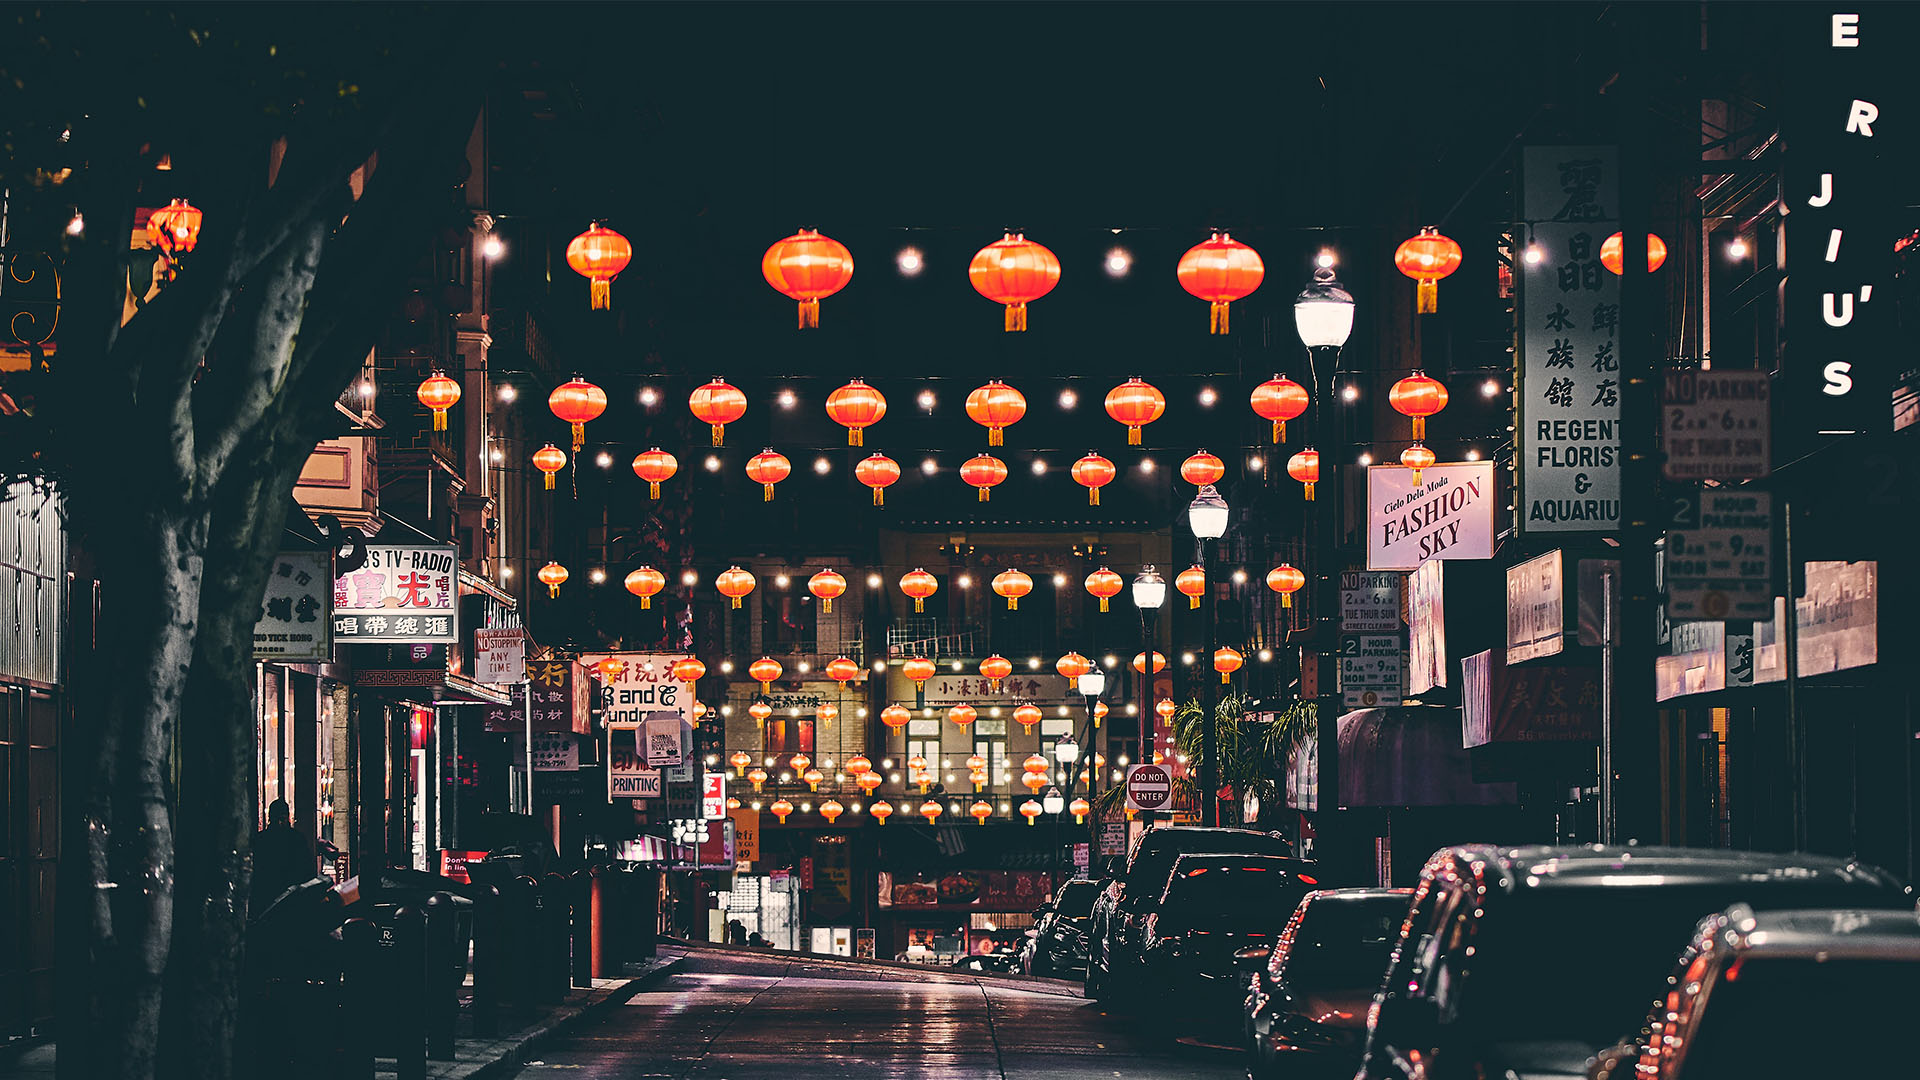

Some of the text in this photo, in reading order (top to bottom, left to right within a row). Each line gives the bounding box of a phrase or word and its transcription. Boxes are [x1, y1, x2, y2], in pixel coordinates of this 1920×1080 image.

[1664, 374, 1768, 400] NO PARKING
[1574, 473, 1593, 494] &
[1384, 476, 1448, 514] Cielo Dela Moda
[1383, 476, 1480, 548] FASHION
[1530, 500, 1620, 522] AQUARIU
[1673, 498, 1691, 523] 2
[1419, 519, 1461, 561] SKY
[385, 551, 453, 574] TV-RADIO
[1342, 574, 1398, 589] NO PARKING
[435, 576, 449, 608] 唱片
[1345, 609, 1395, 619] TUE THUR SUN
[289, 634, 312, 642] HONG
[478, 638, 521, 650] NO STOPPING
[1346, 639, 1392, 654] 2 HOUR
[1362, 648, 1399, 657] PARKING
[490, 652, 509, 661] ANY
[488, 664, 511, 672] TIME
[1344, 674, 1365, 683] MON
[1383, 674, 1397, 682] SAT
[620, 684, 655, 704] and
[613, 777, 658, 791] PRINTING
[1135, 773, 1165, 781] DO NOT
[1136, 793, 1165, 801] ENTER
